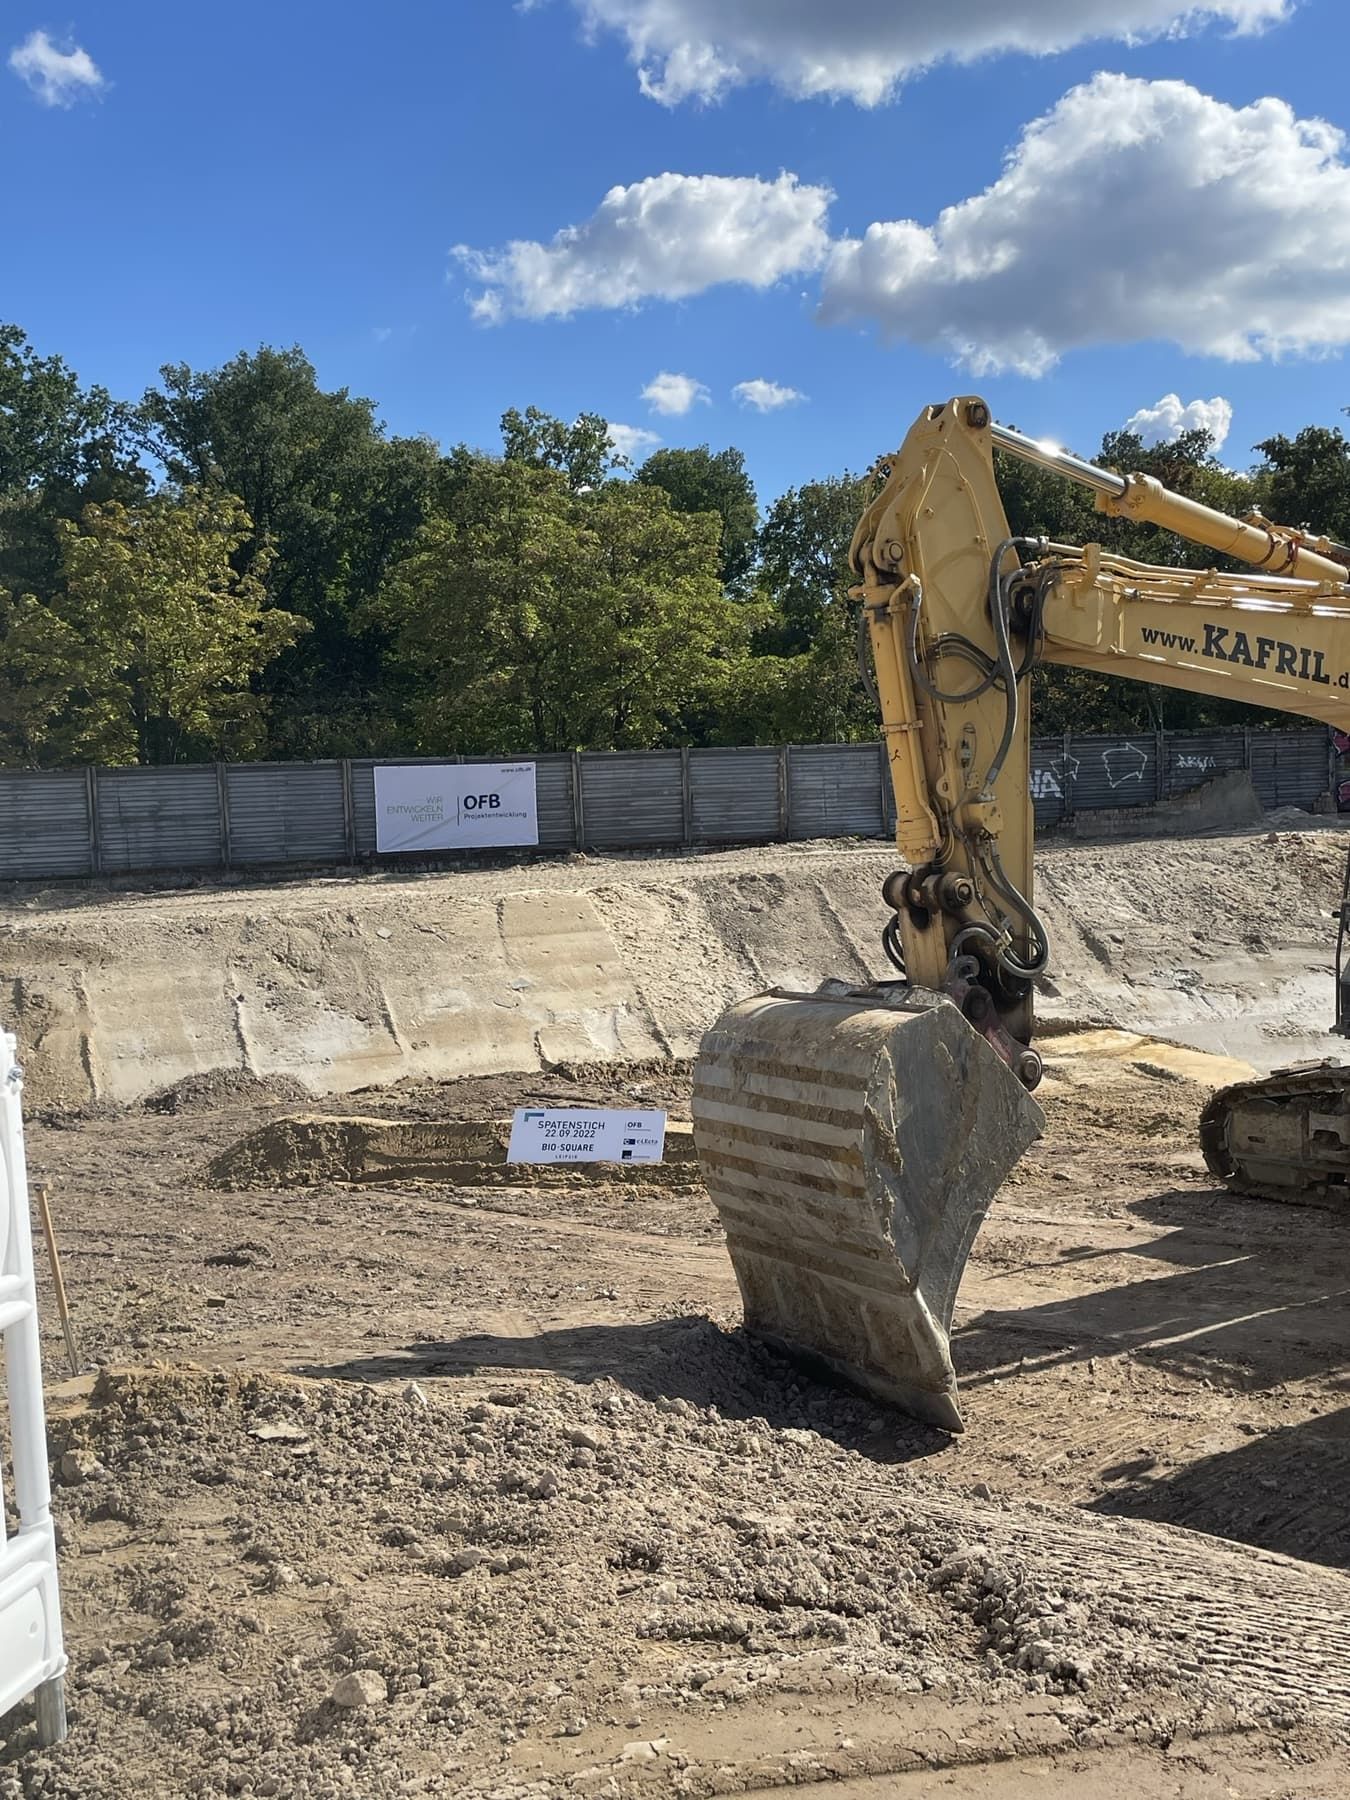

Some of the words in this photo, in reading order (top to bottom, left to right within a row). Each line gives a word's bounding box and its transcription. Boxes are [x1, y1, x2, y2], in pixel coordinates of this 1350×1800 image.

[426, 796, 443, 804] WIR
[463, 794, 501, 810] OFB
[386, 805, 444, 815] ENTWICKELN
[411, 813, 444, 823] WEITER
[463, 811, 527, 820] Projektentwicklung
[538, 1120, 605, 1130] SPATENSTICH
[545, 1129, 596, 1138] 22.09.2022
